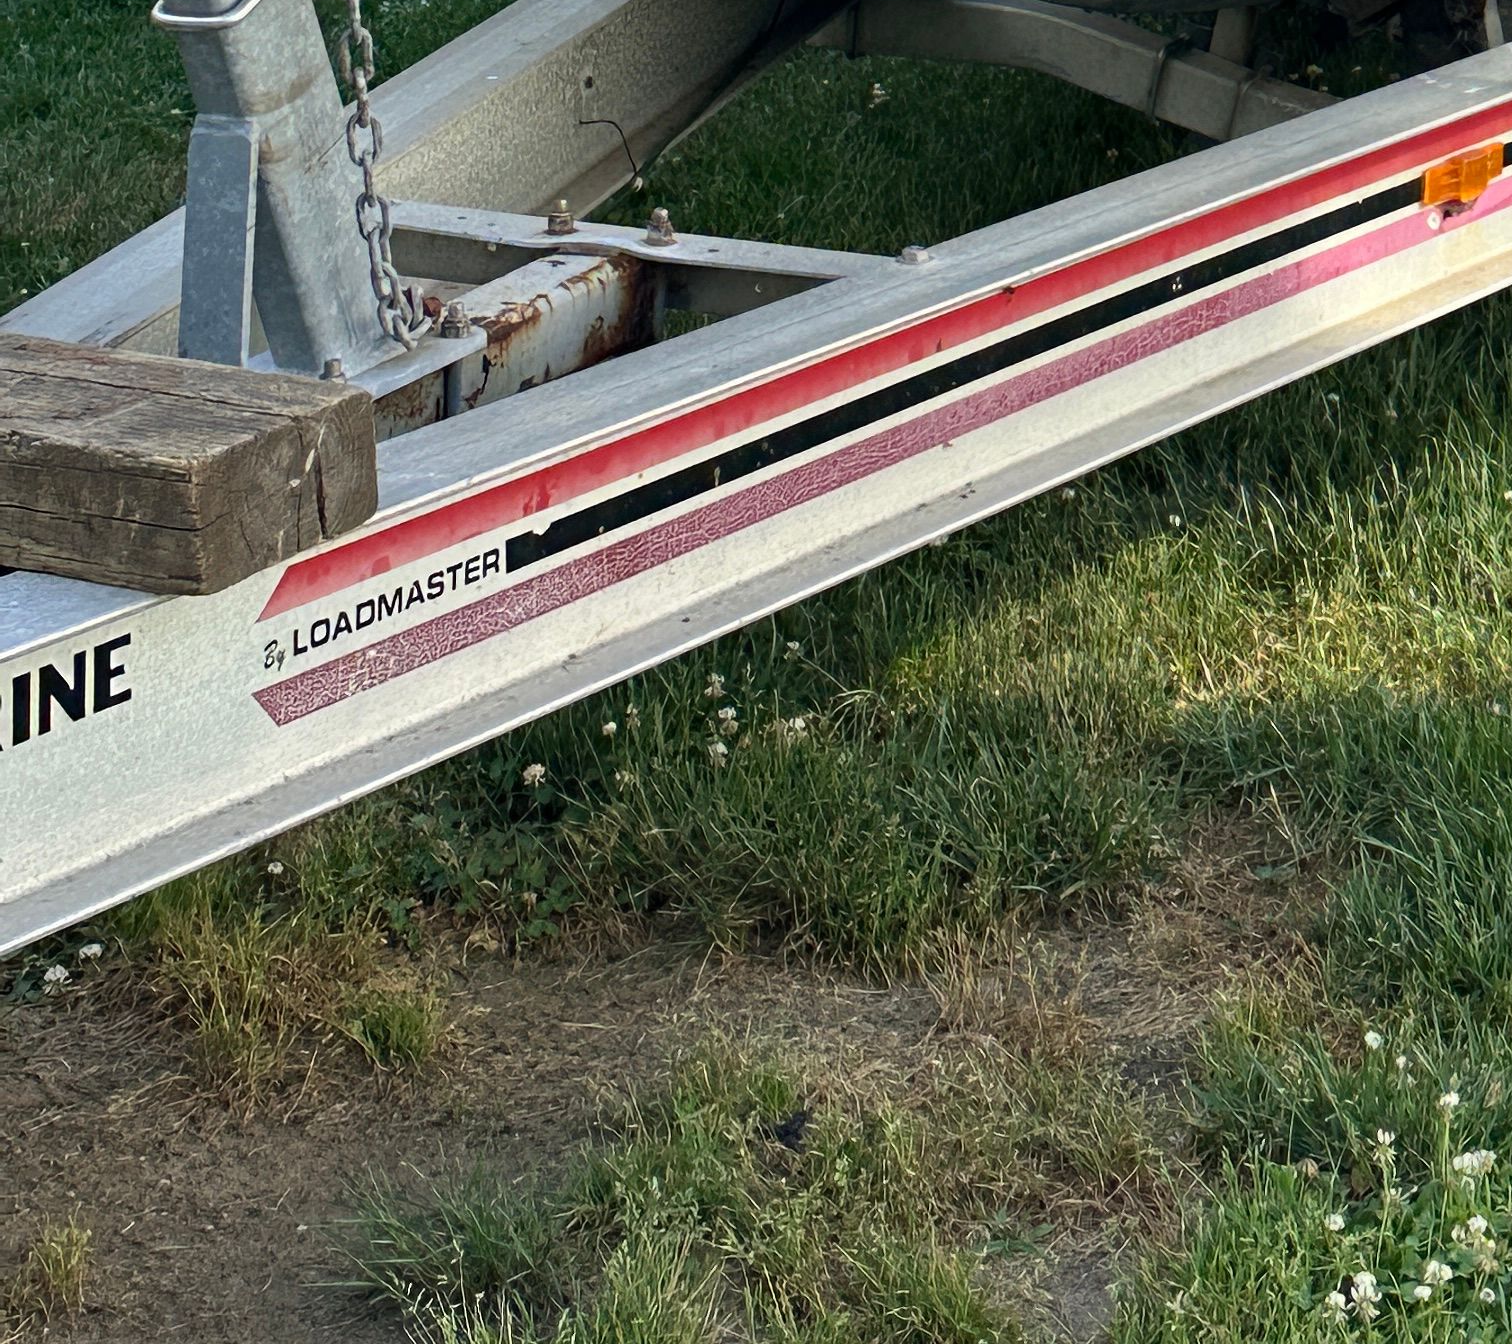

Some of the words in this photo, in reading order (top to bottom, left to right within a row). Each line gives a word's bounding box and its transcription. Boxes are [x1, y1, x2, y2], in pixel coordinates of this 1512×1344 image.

[263, 639, 285, 671] By
[293, 548, 500, 656] LOADMASTER
[0, 633, 132, 752] INE
